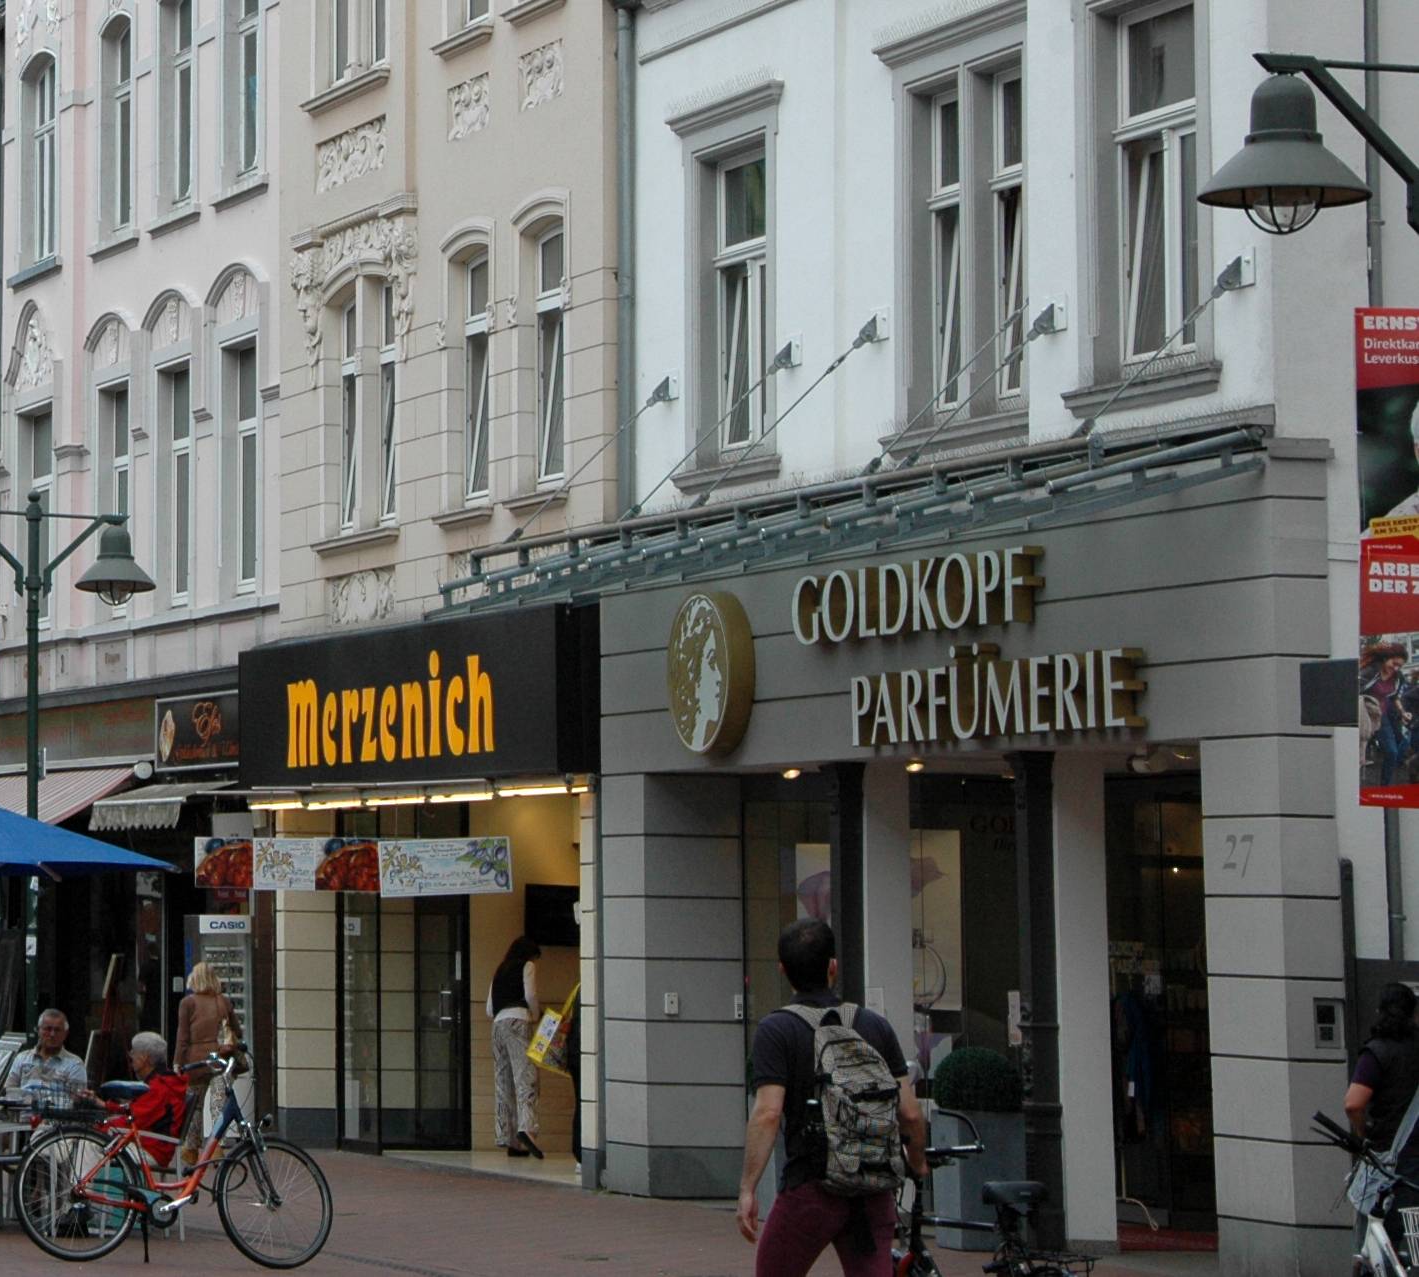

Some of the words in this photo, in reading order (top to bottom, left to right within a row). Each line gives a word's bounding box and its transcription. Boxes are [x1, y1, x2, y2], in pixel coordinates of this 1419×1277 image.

[1363, 316, 1419, 331] ERNS
[791, 546, 1029, 646] GOLDKOPF
[1369, 579, 1408, 594] DER
[286, 650, 495, 768] Merzenich
[850, 642, 1131, 747] PARFÜMERIE
[1223, 834, 1254, 878] 27
[210, 921, 246, 930] CASIO
